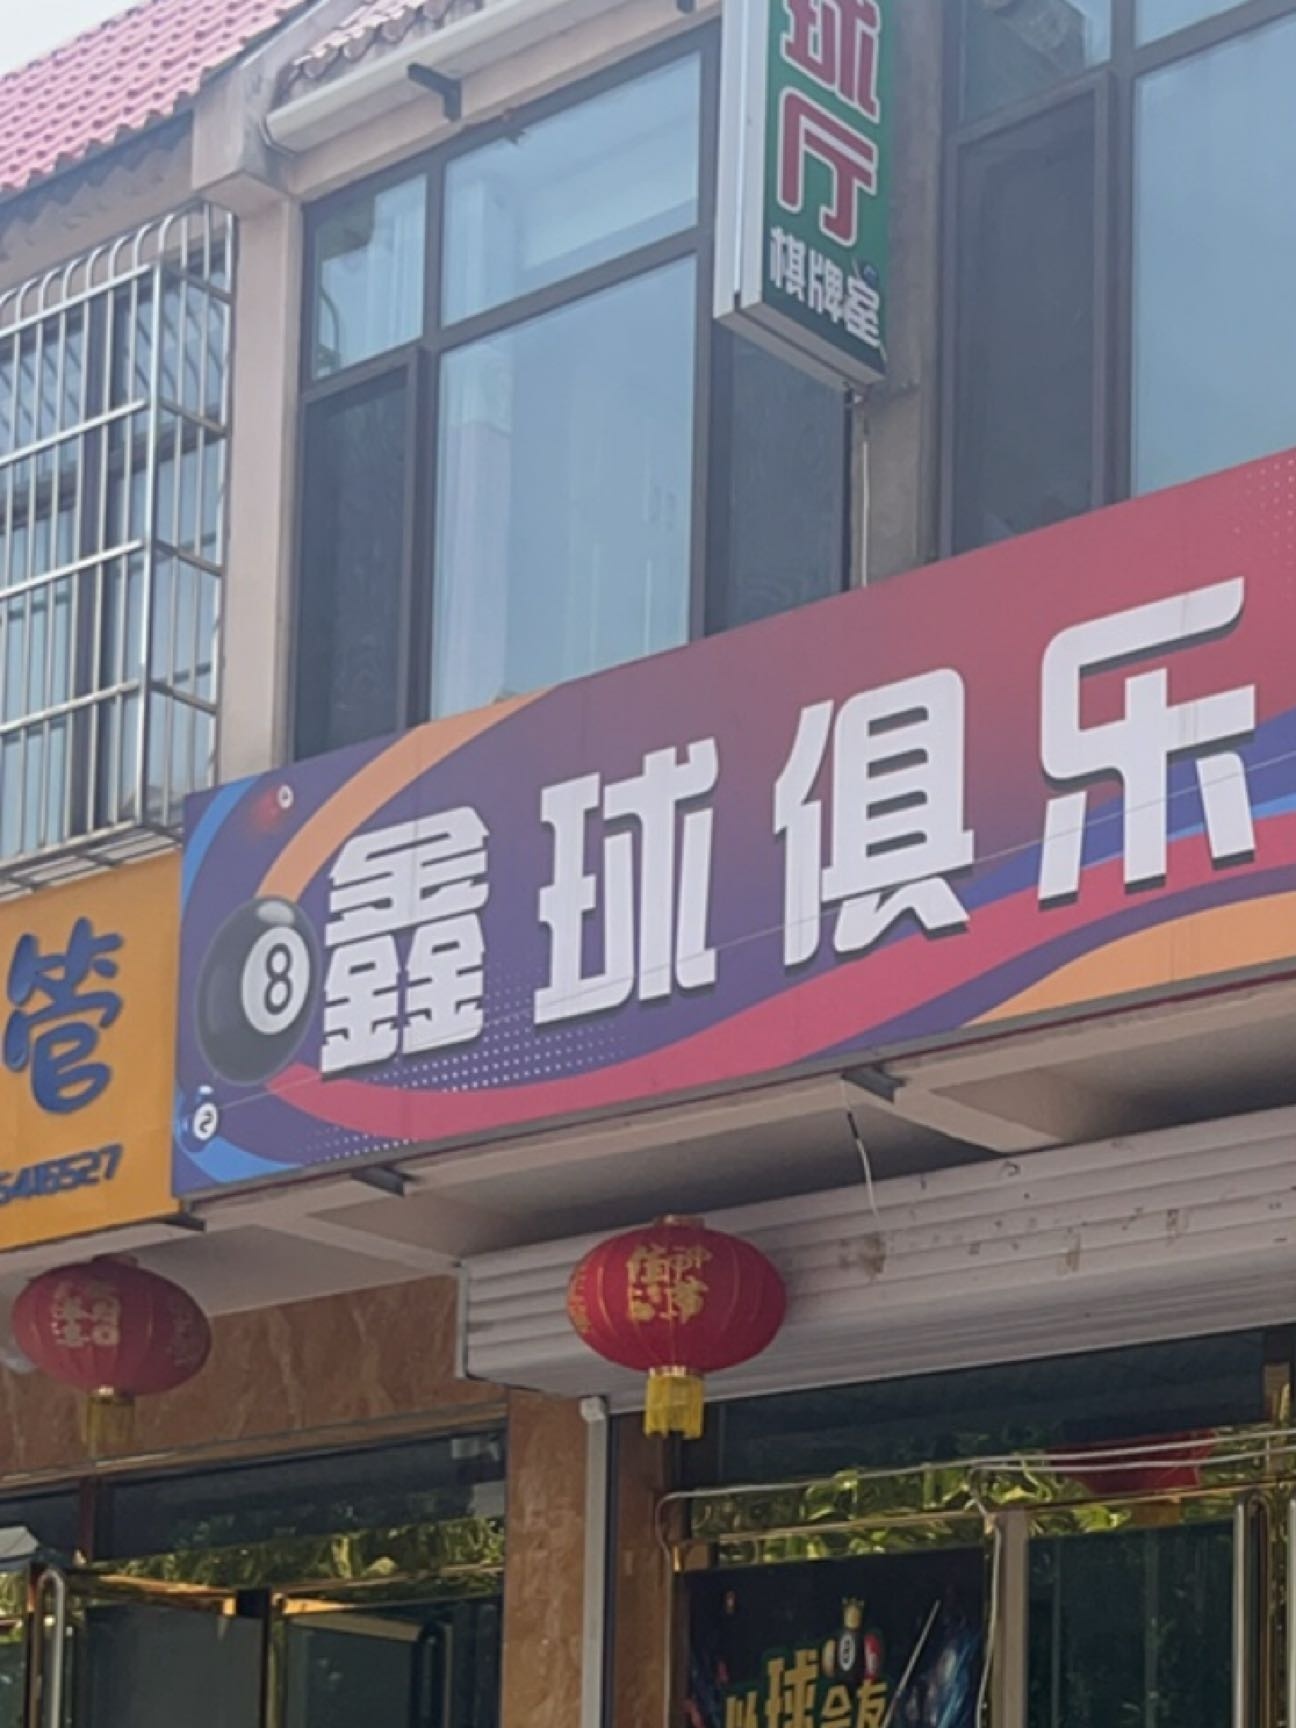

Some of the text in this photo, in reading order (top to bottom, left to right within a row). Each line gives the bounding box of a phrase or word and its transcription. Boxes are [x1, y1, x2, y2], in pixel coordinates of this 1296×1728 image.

[769, 226, 881, 348] 棋牌室
[3, 915, 124, 1115] 管
